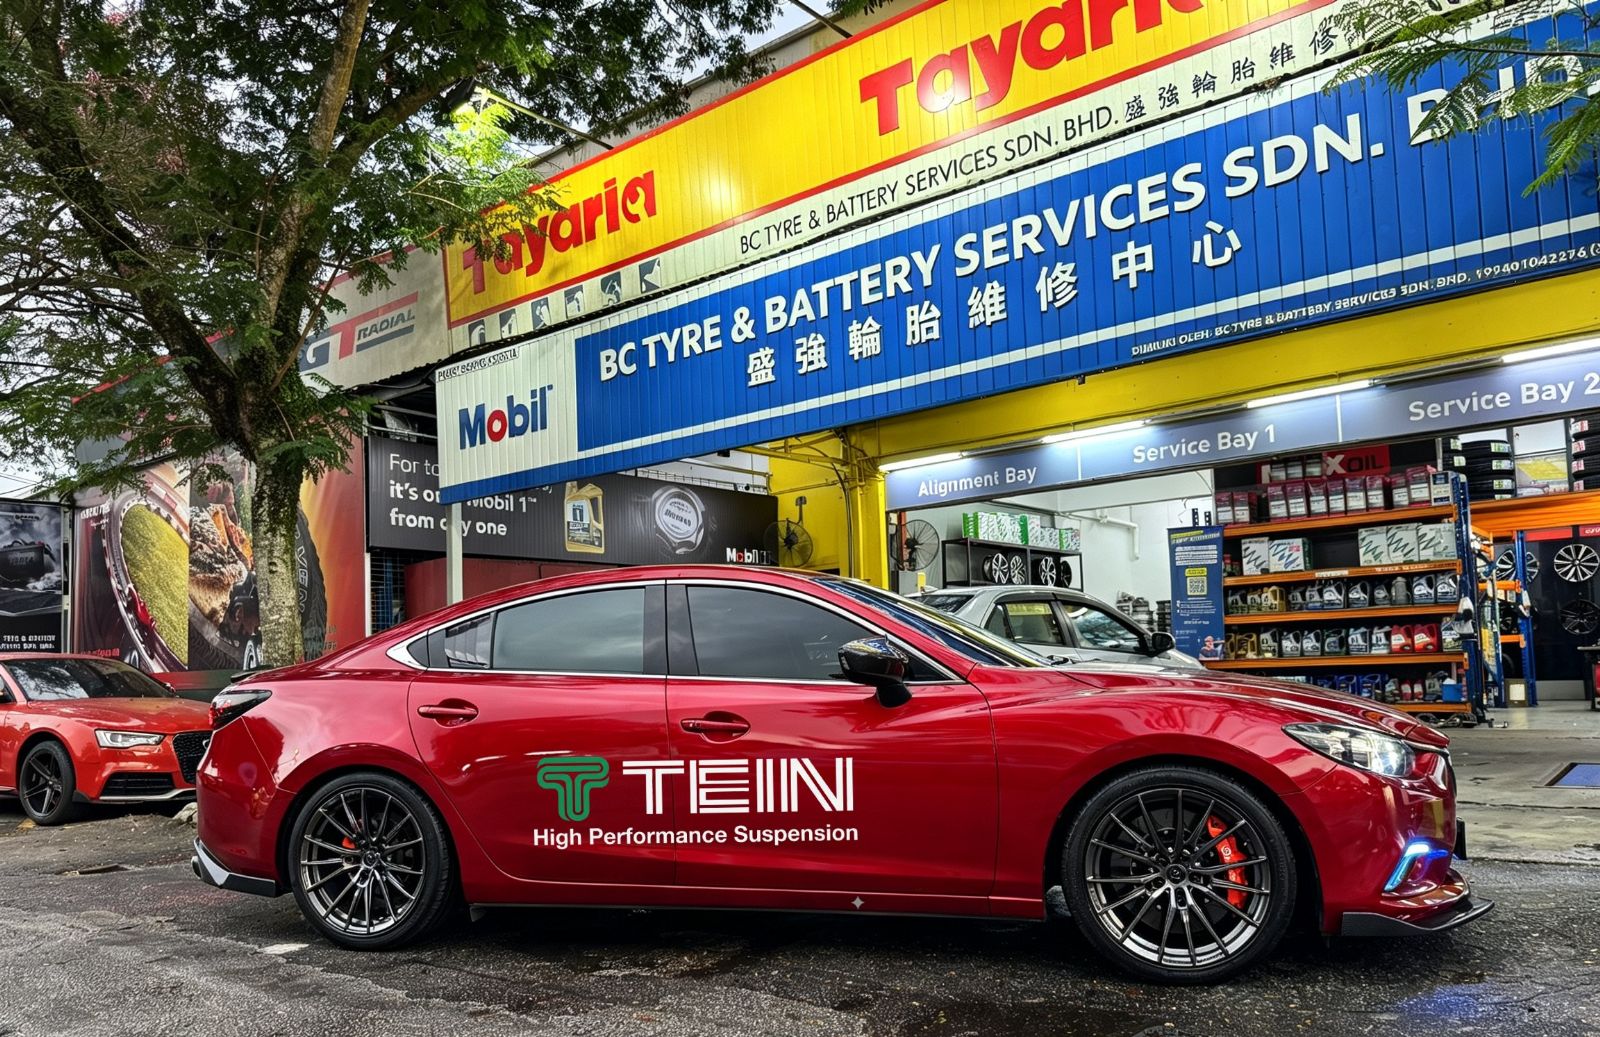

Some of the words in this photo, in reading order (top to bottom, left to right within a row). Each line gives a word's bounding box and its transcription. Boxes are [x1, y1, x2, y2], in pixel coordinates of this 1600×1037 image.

[740, 229, 761, 254] BC
[764, 214, 802, 245] TYRE
[808, 209, 821, 231] &
[826, 180, 898, 225] BATTERY
[905, 145, 998, 196] SERVICES
[1003, 126, 1059, 162] SDN.
[1064, 105, 1119, 142] BHD.
[462, 170, 656, 295] Tayaria
[599, 342, 637, 382] BC
[641, 314, 722, 369] TYRE
[731, 305, 756, 344] &
[764, 243, 942, 334] BATTERY
[954, 162, 1208, 279] SERVICES
[1222, 112, 1385, 200] SDN.
[357, 309, 416, 341] RADIAL
[747, 220, 1242, 388] 盛強輪胎維修中心
[1409, 391, 1511, 422] Service
[1520, 380, 1575, 404] Bay
[1583, 372, 1600, 396] 2
[389, 453, 419, 474] For
[1133, 438, 1210, 464] Service
[1217, 431, 1259, 451] Bay
[1265, 424, 1275, 444] 1
[918, 471, 999, 497] Alignment
[1005, 466, 1037, 485] Bay
[389, 507, 434, 529] from
[475, 521, 508, 535] one
[622, 757, 855, 815] TEIN
[532, 828, 582, 850] High
[589, 826, 727, 845] Performance
[734, 824, 859, 845] Suspension
